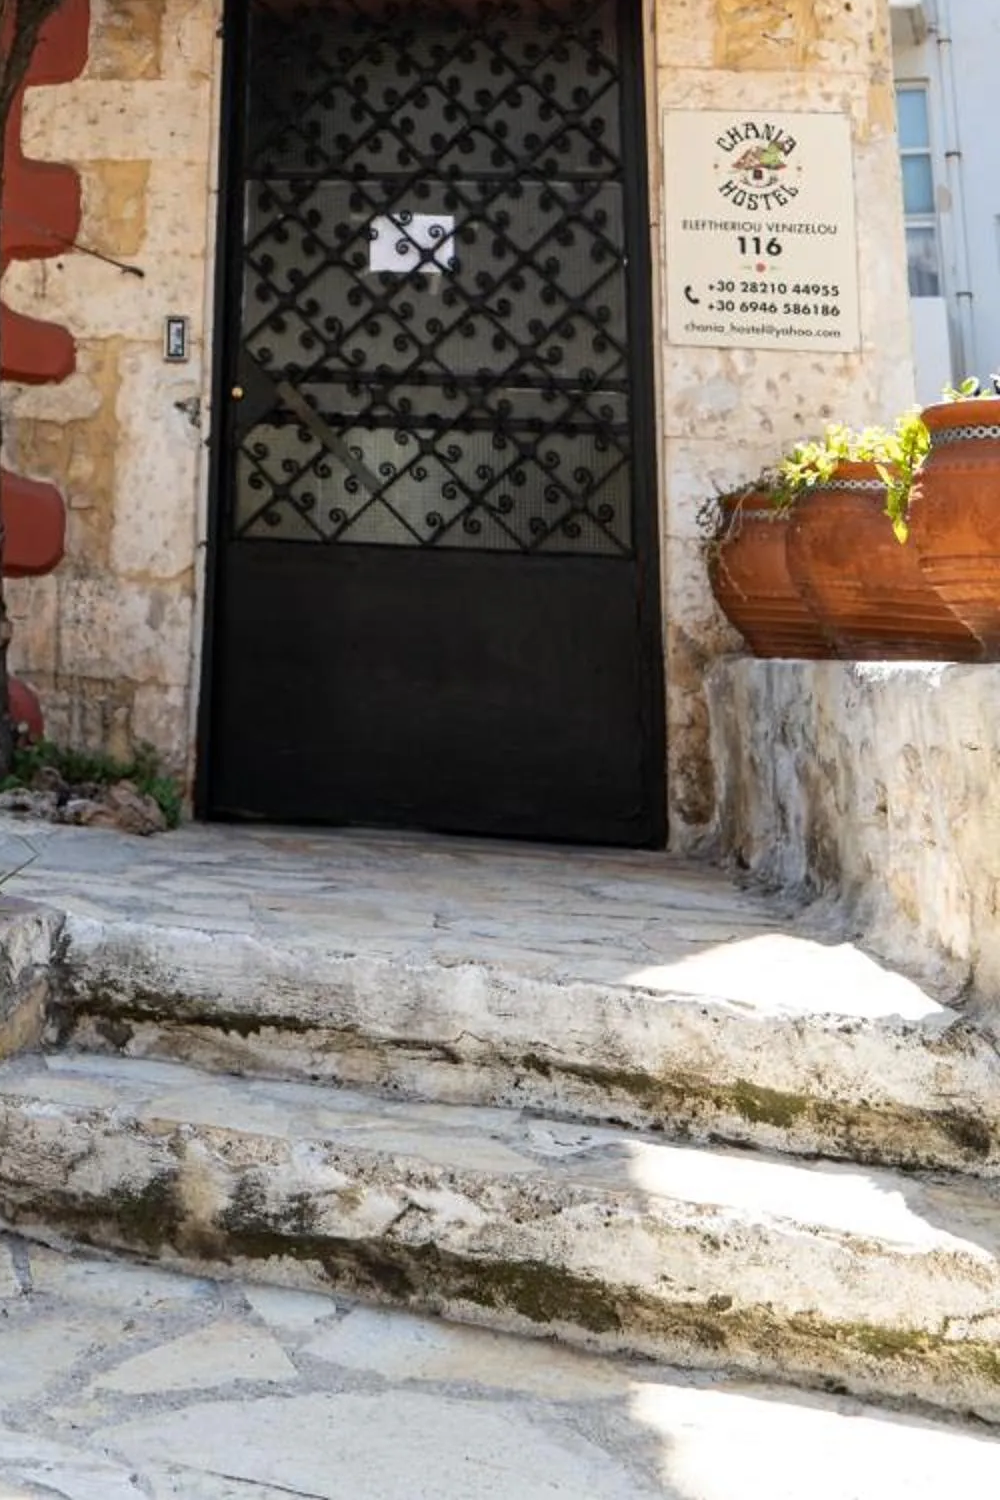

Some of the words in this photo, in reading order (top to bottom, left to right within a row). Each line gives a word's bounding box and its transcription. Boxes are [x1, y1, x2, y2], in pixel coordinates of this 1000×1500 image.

[716, 121, 797, 157] CHANIA
[718, 179, 799, 212] HOSTEL
[681, 219, 762, 233] ELEFTHERIOU
[765, 221, 838, 235] VENIZELOU
[737, 235, 783, 256] 116
[708, 280, 735, 293] +30
[740, 281, 787, 295] 28210
[792, 283, 840, 297] 44955
[708, 300, 735, 312] +30
[739, 301, 778, 314] 6946
[783, 303, 841, 317] 586186
[684, 319, 841, 338] chania_hostel@yahoo.com
